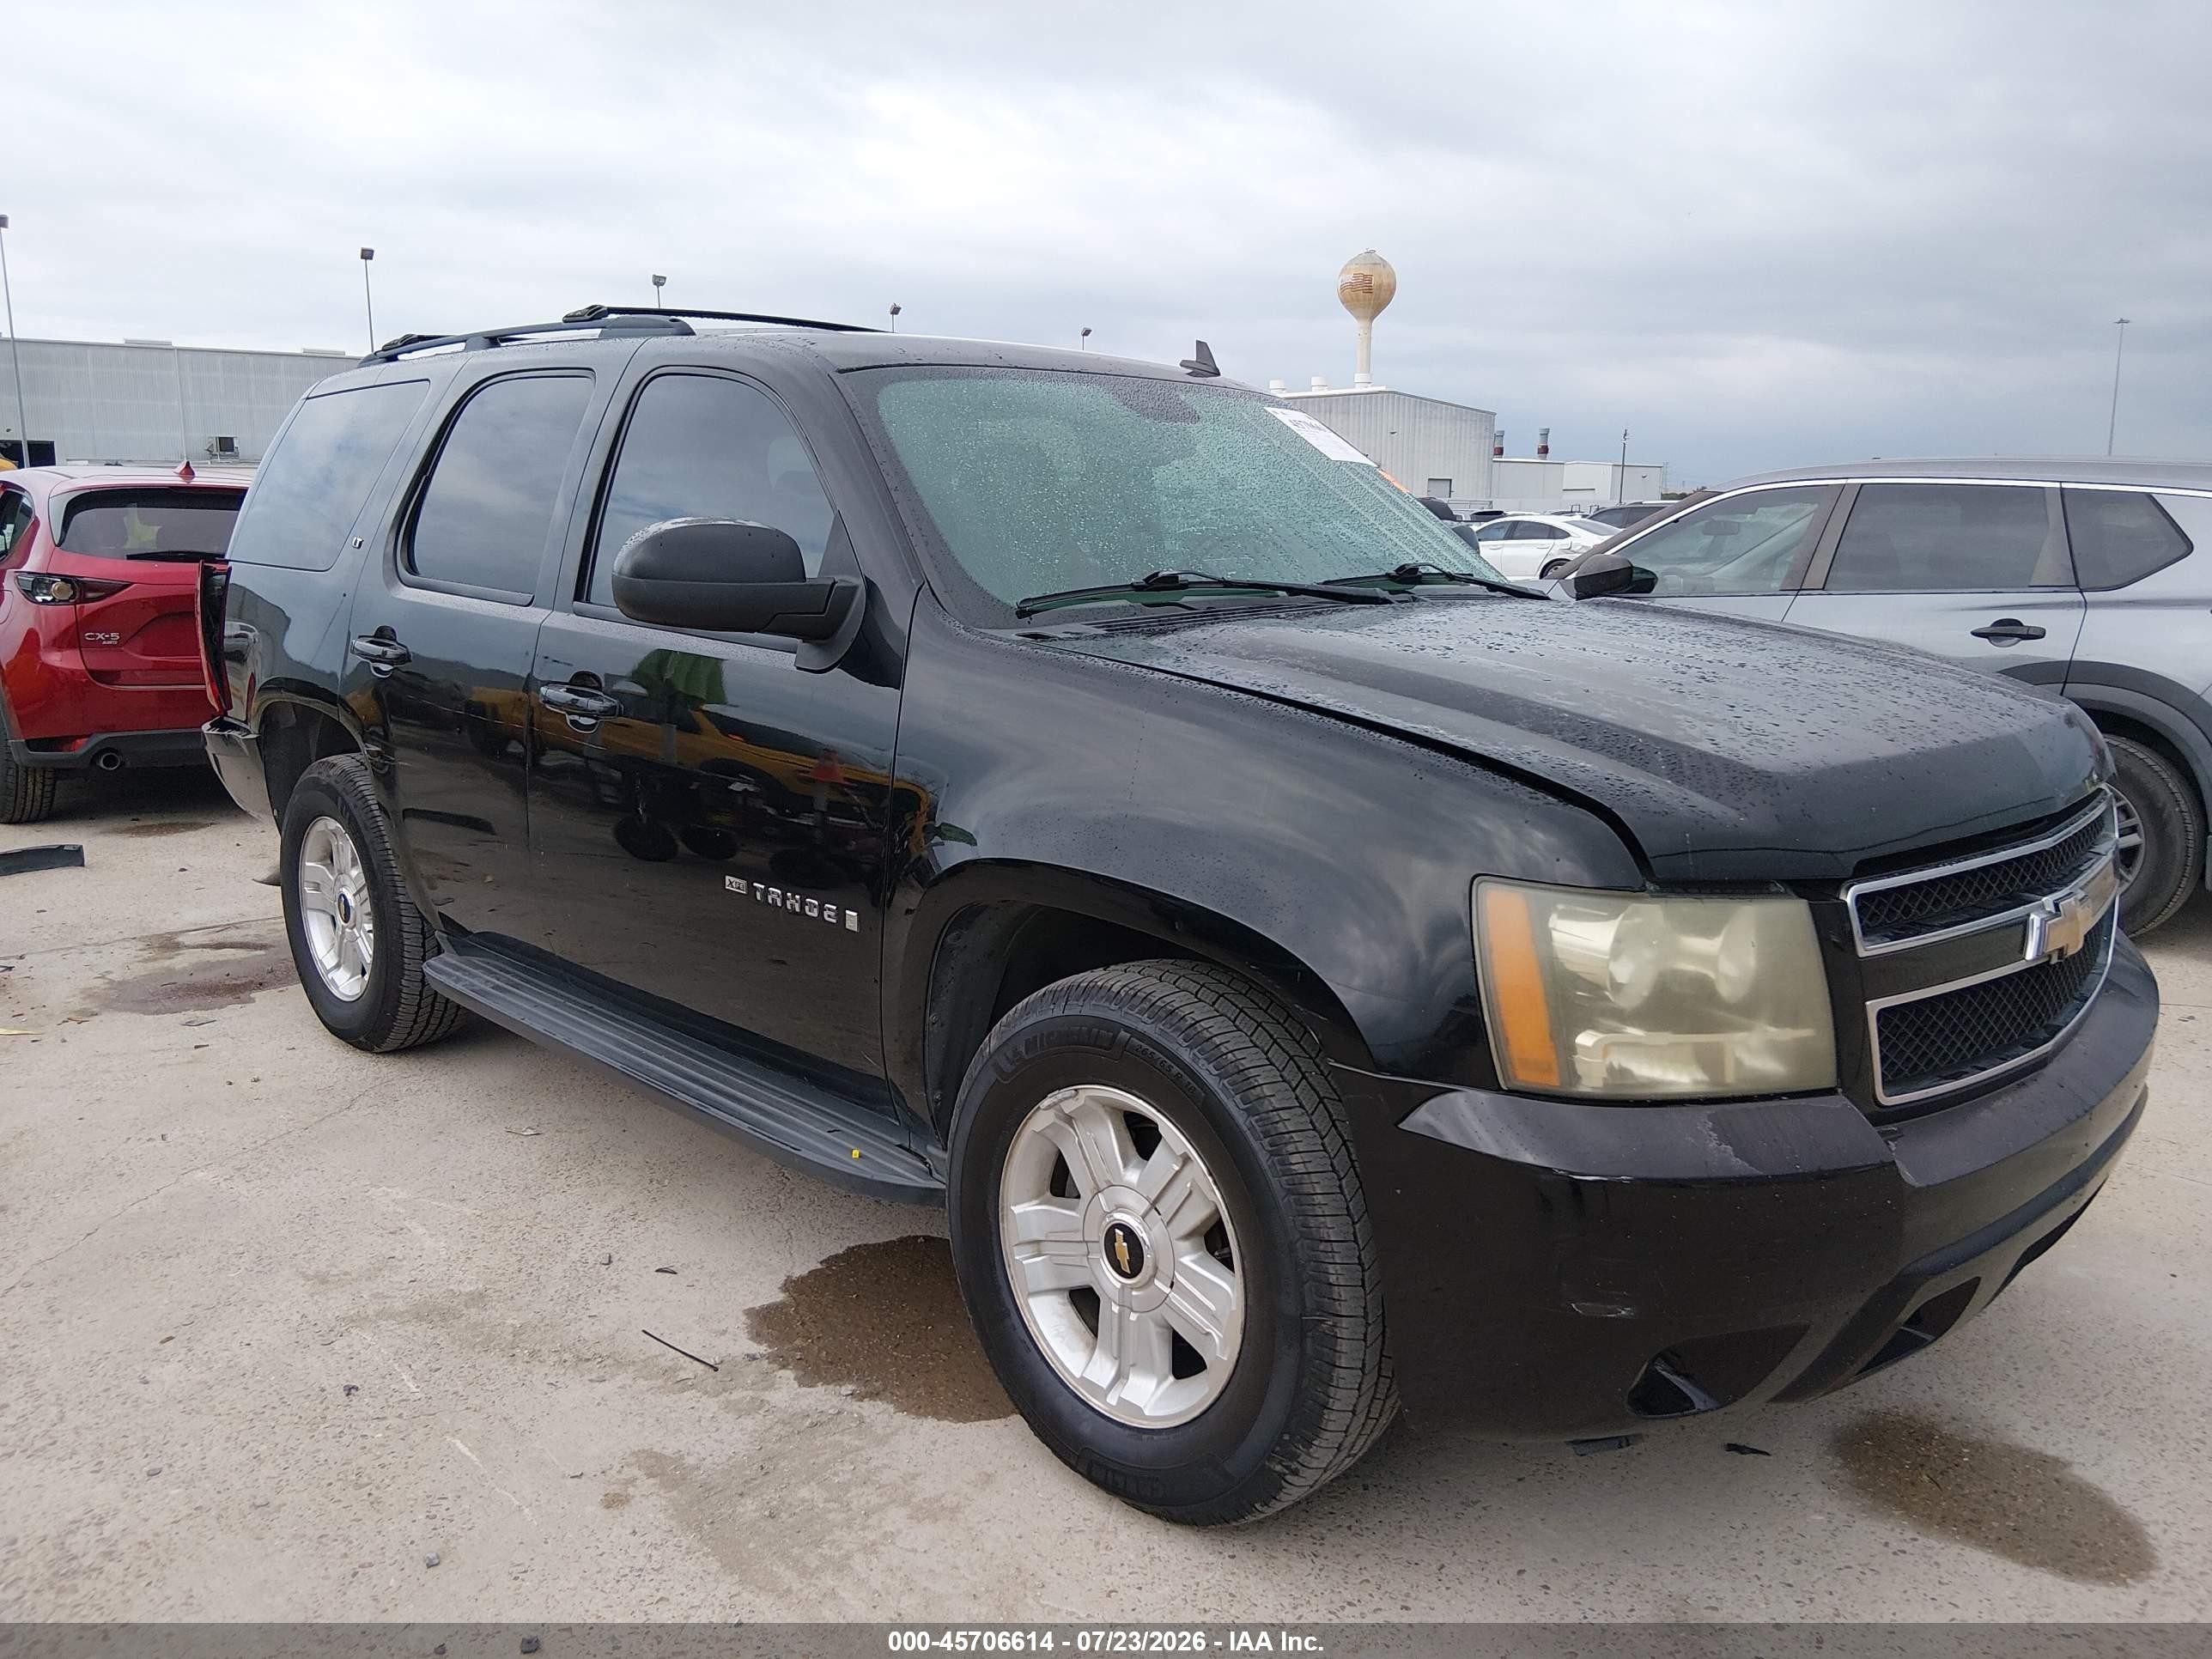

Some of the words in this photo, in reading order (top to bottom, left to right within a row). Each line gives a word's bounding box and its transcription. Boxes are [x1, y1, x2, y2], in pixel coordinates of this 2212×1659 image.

[352, 536, 364, 549] LT
[85, 632, 120, 641] CX-5
[752, 882, 838, 923] TAHOE
